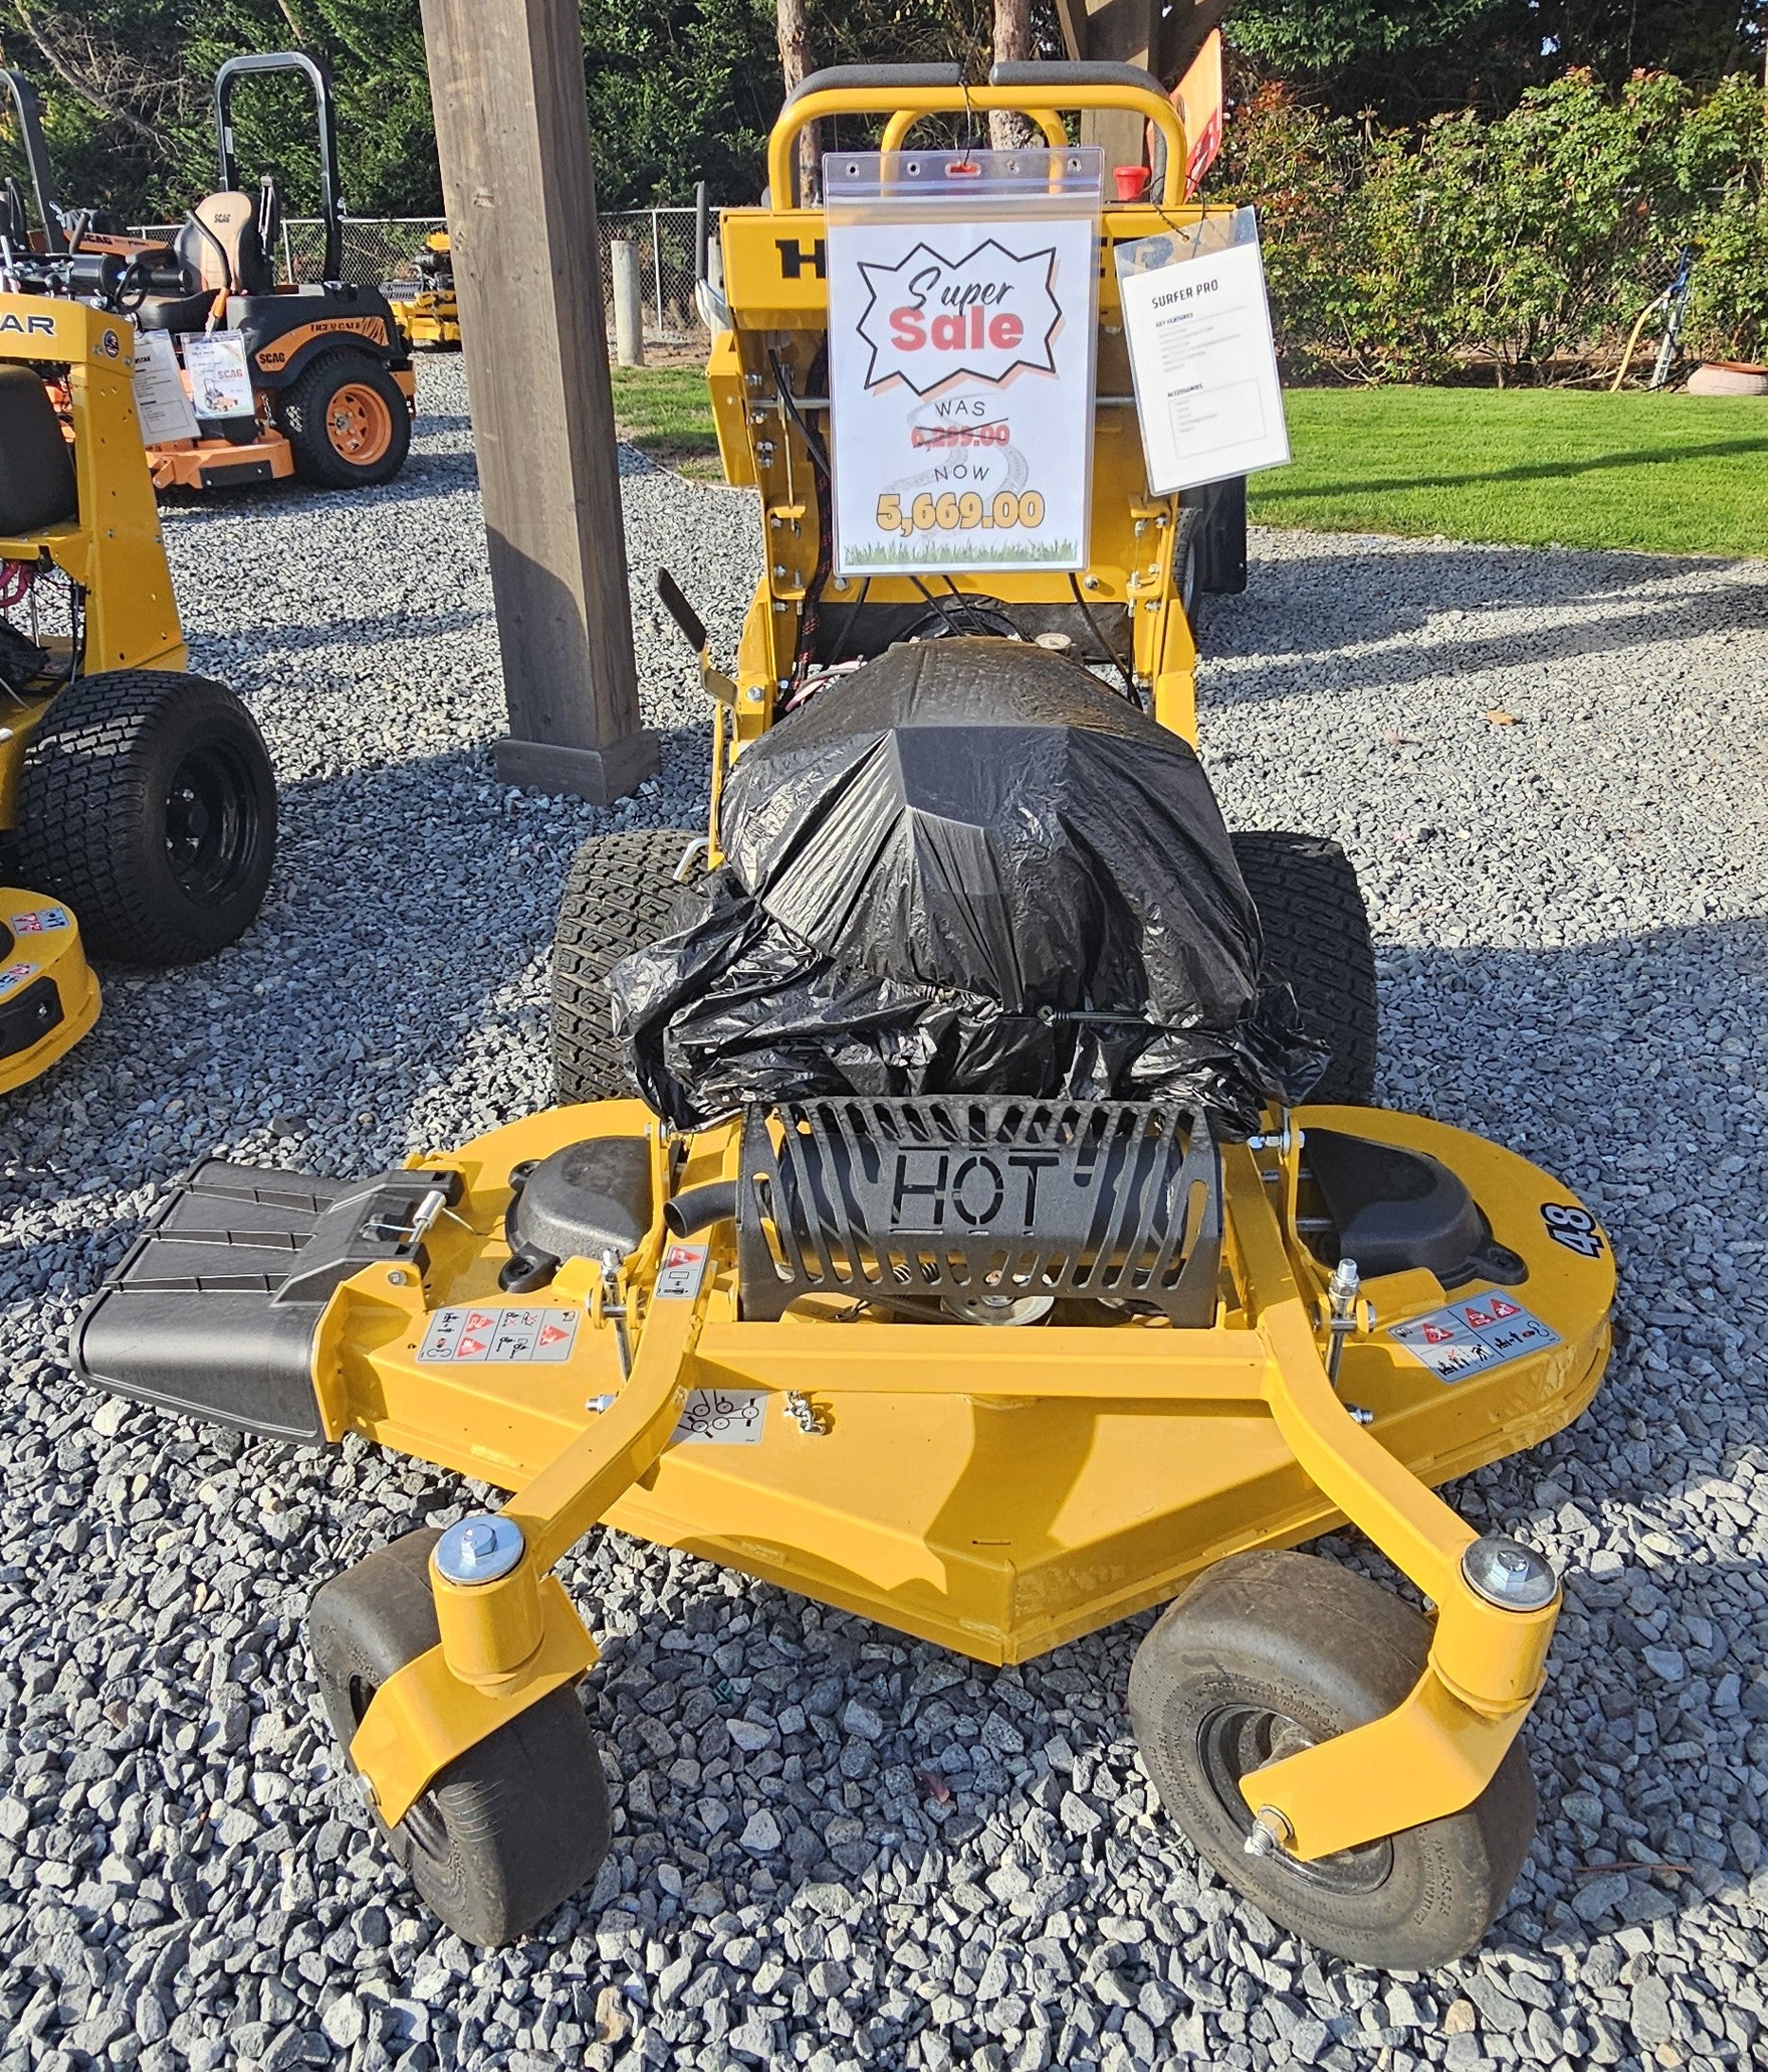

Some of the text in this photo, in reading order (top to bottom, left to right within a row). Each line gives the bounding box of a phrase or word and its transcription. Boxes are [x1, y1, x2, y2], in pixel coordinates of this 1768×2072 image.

[908, 266, 1015, 317] Super
[1152, 279, 1219, 310] SURFER PRO
[888, 305, 1024, 352] Sale
[218, 368, 243, 380] SCAG
[258, 352, 286, 364] SCAG
[934, 400, 985, 417] WAS
[933, 464, 990, 482] NOW
[875, 490, 1046, 538] 5,669.00
[890, 1148, 1060, 1233] HOT
[1540, 1202, 1604, 1259] 48
